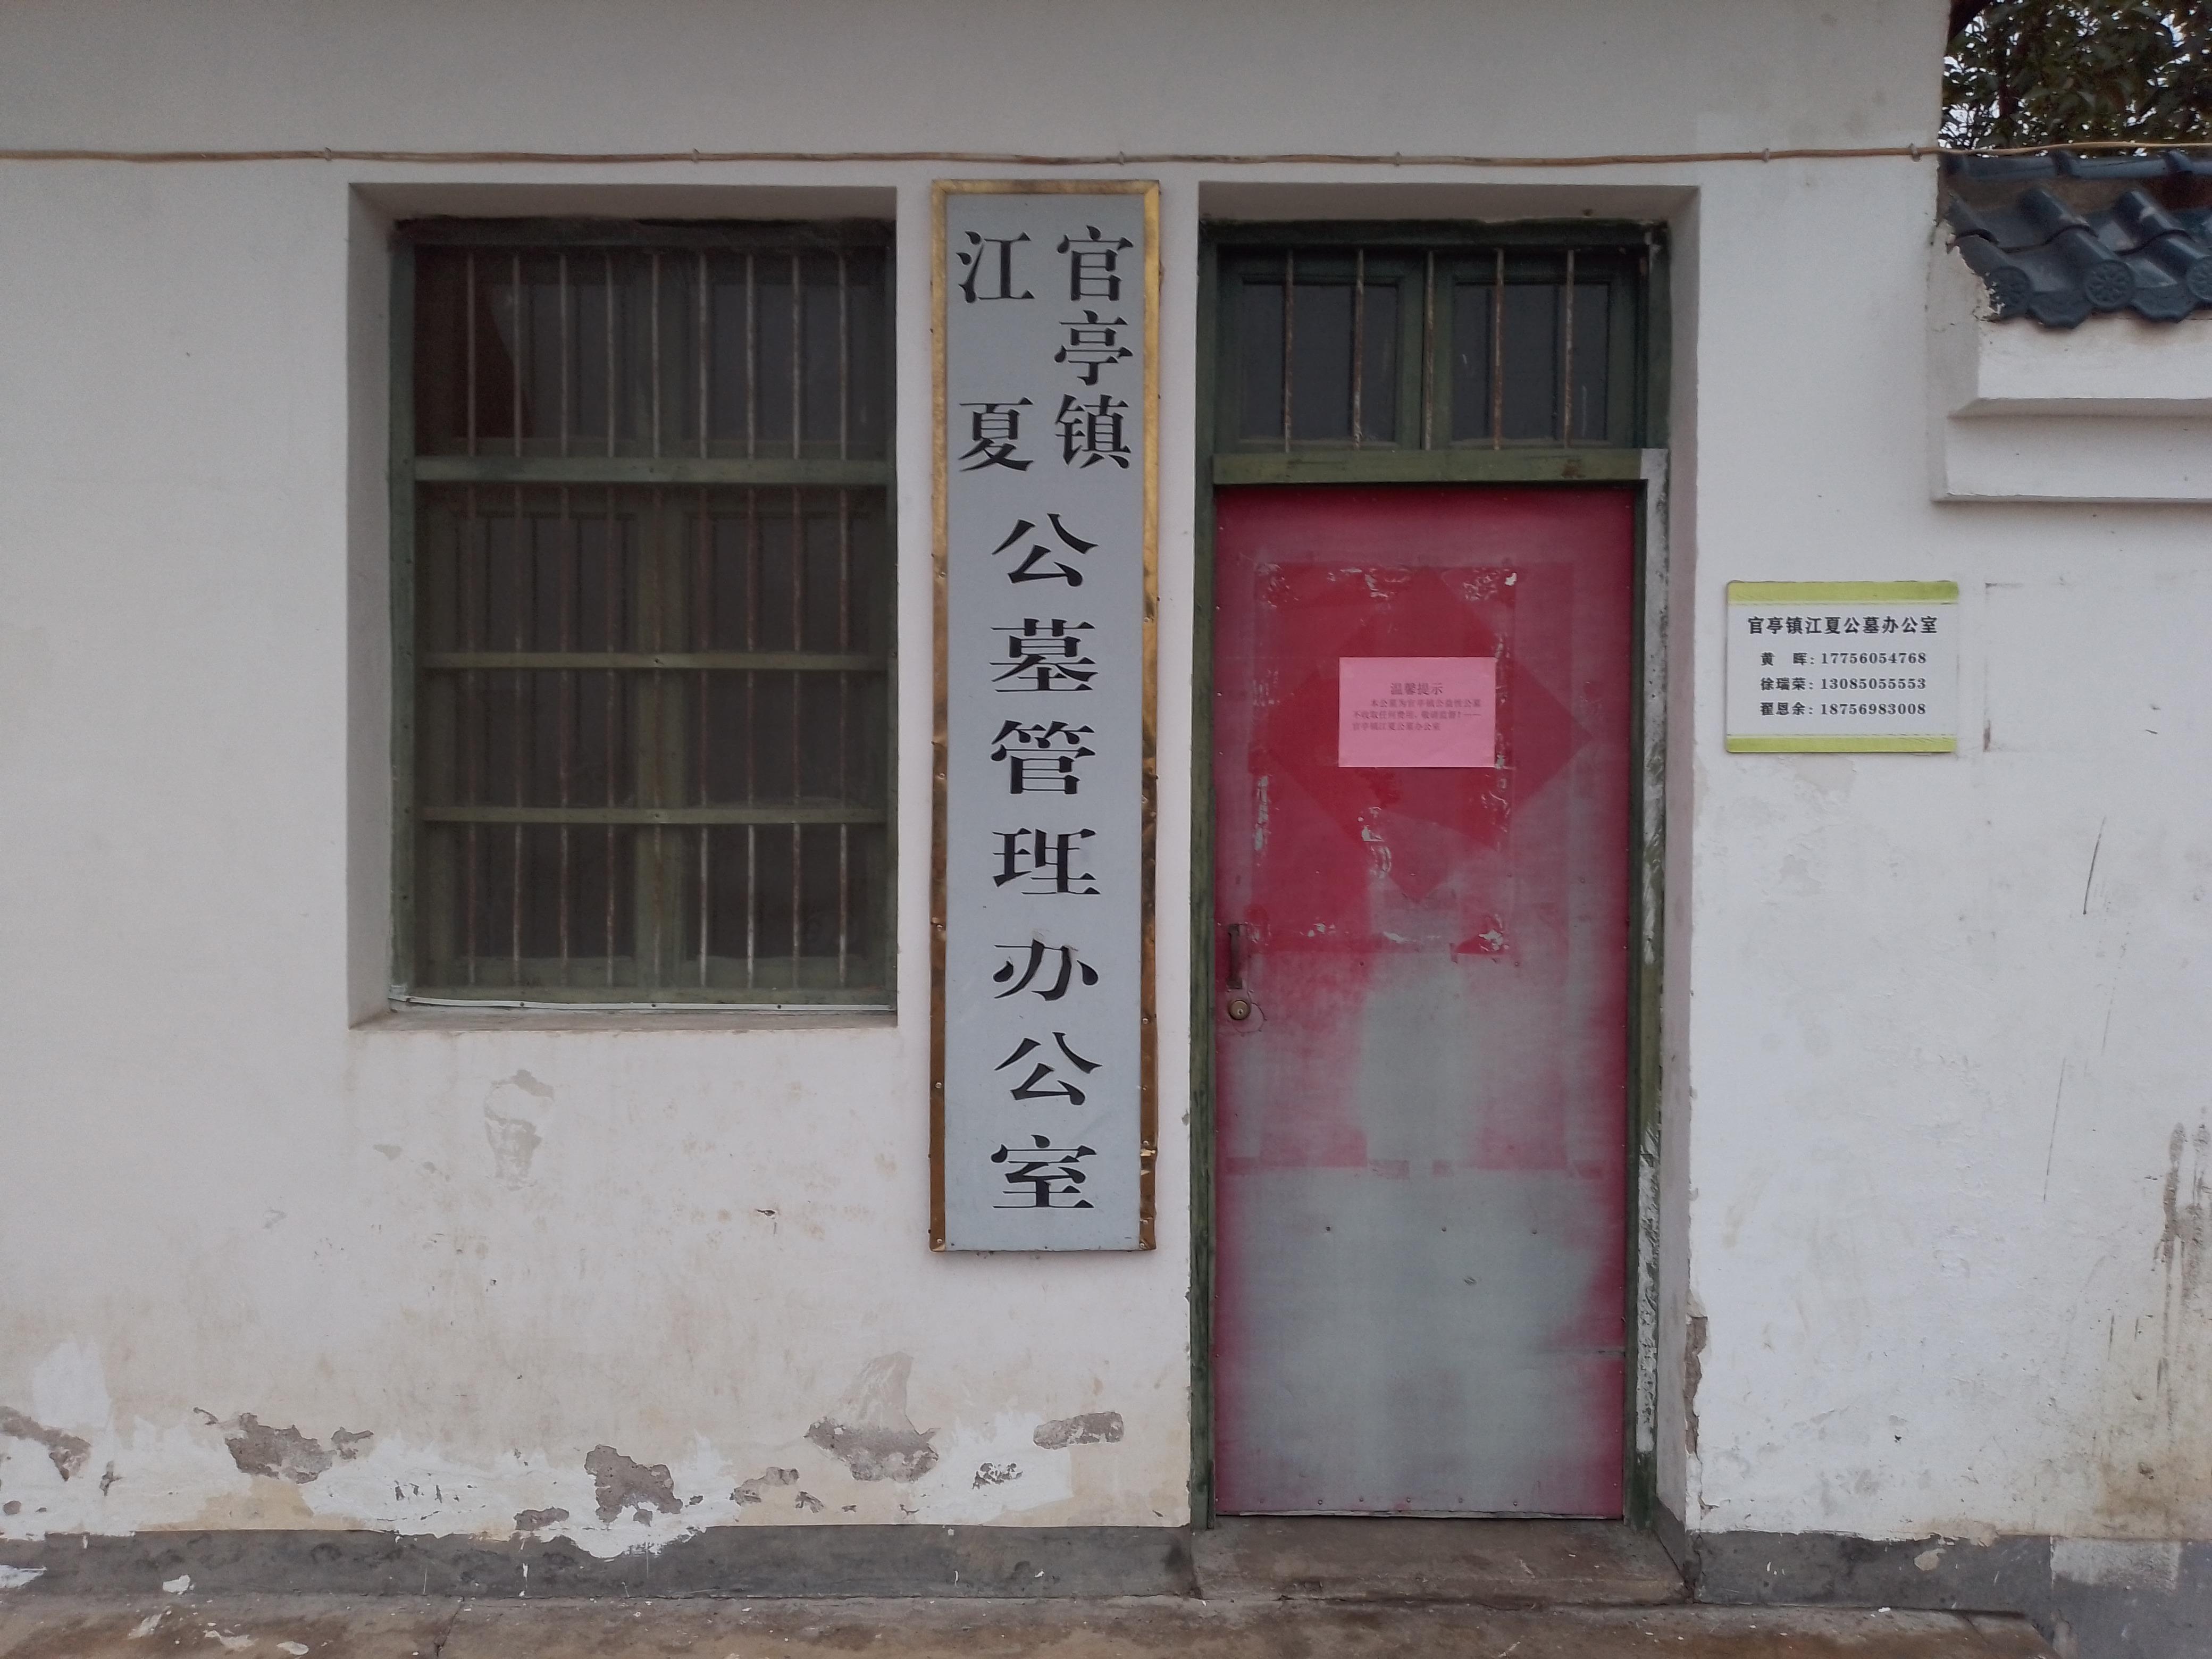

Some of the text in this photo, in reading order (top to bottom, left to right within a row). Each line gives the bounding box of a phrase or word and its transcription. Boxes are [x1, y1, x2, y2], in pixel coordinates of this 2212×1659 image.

[956, 231, 1035, 472] 江夏
[1053, 225, 1134, 469] 官亭镇
[1390, 683, 1443, 695] 温馨提示
[1747, 615, 1938, 634] 官亭镇江夏公墓办公室
[989, 513, 1103, 1210] 公墓管理办公室
